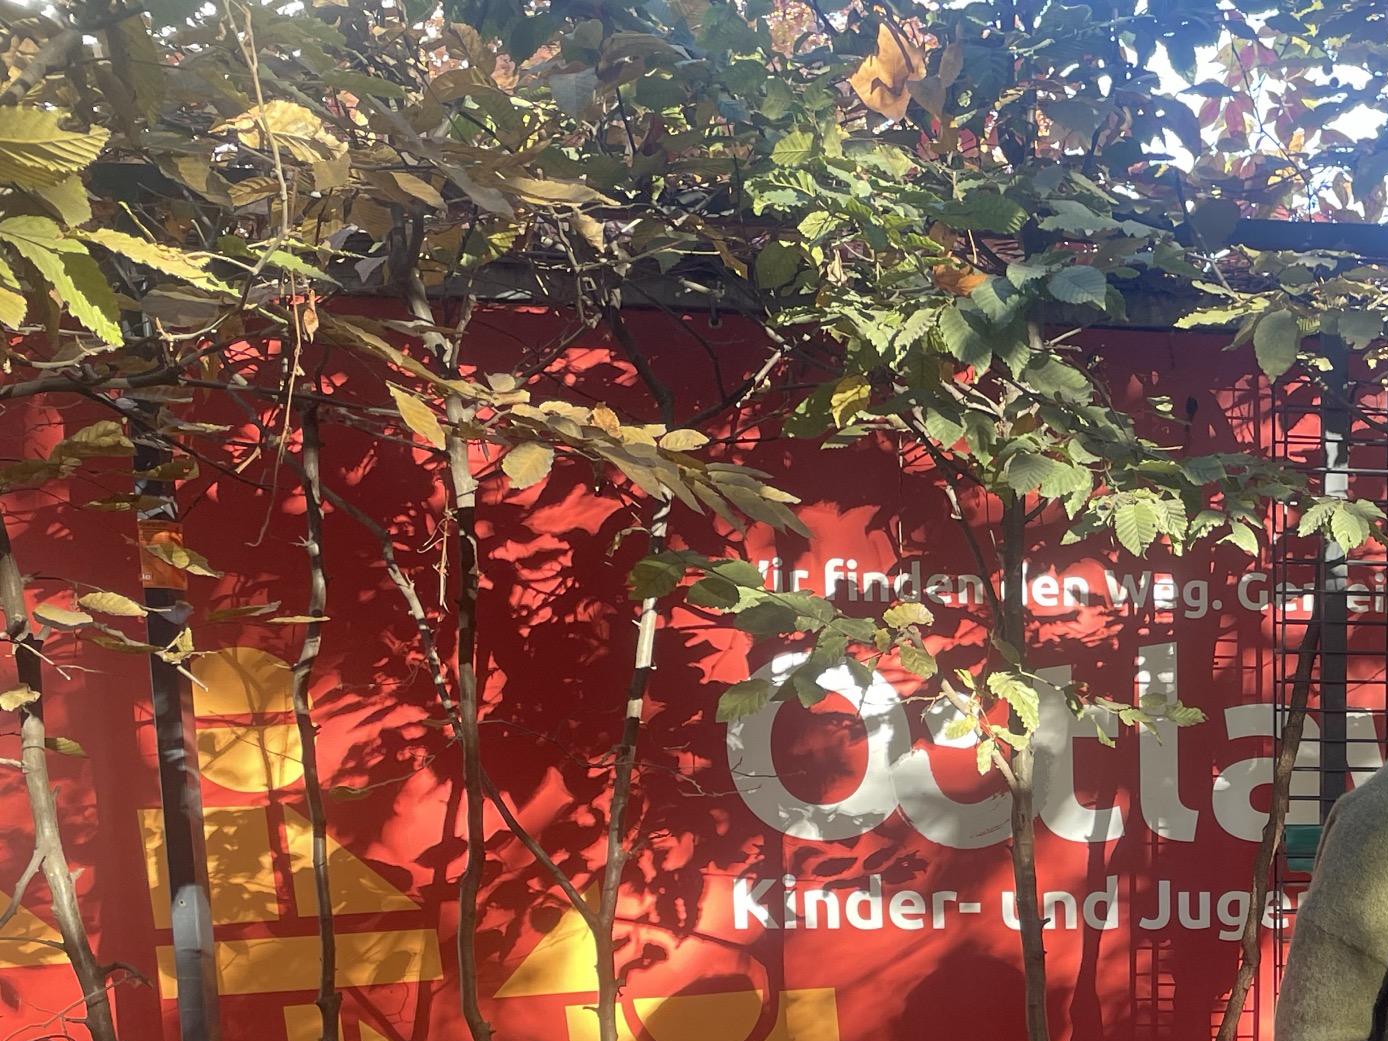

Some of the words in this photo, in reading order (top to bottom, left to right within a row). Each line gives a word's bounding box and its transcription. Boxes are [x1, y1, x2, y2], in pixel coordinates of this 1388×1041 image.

[757, 556, 809, 595] ir
[824, 557, 984, 605] finden
[1104, 569, 1222, 619] Weg.
[733, 873, 982, 931] Kinder-
[1001, 875, 1118, 931] und
[1139, 880, 1310, 941] Juge
